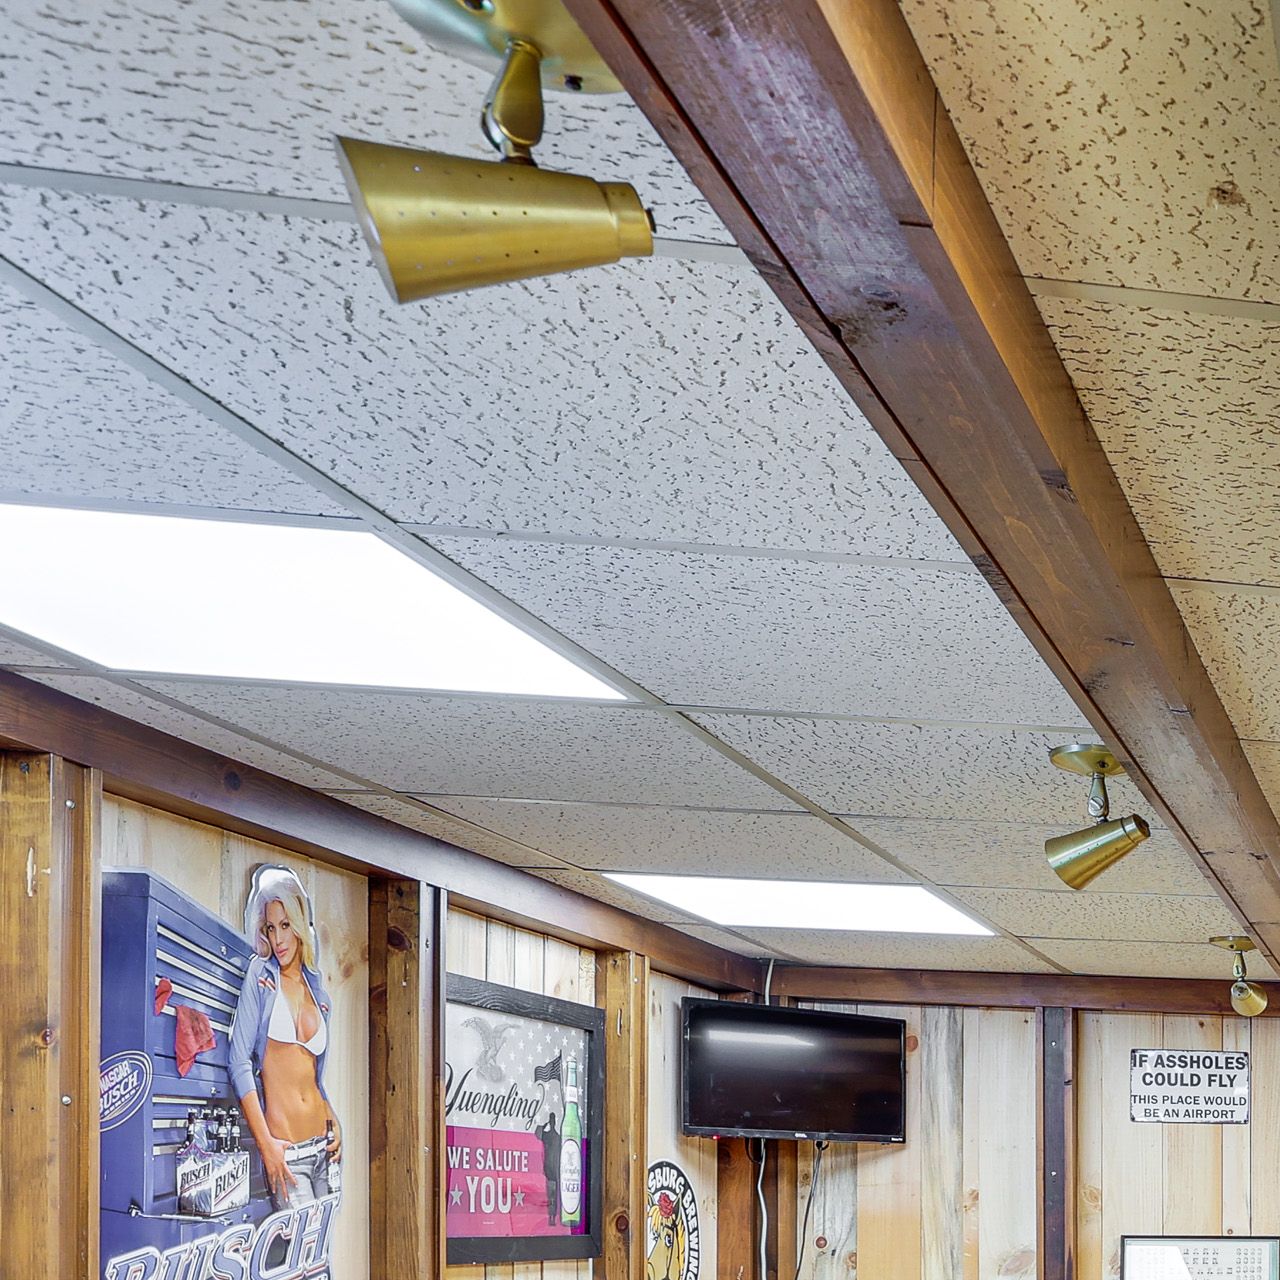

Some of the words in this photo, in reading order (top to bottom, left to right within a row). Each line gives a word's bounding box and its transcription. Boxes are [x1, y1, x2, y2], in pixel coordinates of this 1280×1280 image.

[1132, 1054, 1148, 1068] IF
[1154, 1054, 1246, 1070] ASSHOLES
[100, 1059, 131, 1094] NASCAR
[1142, 1072, 1202, 1087] COULD
[1207, 1074, 1237, 1088] FLY
[445, 1061, 546, 1131] Yuengling
[1131, 1094, 1158, 1104] THIS
[1162, 1095, 1200, 1105] PLACE
[1203, 1096, 1247, 1106] WOULD
[1144, 1108, 1159, 1118] BE
[1163, 1108, 1180, 1118] AN
[1183, 1109, 1236, 1119] AIRPORT
[448, 1146, 471, 1169] WE
[476, 1148, 529, 1173] SALUTE
[181, 1162, 211, 1190] BUSCH
[215, 1155, 249, 1197] BUSCH
[466, 1175, 512, 1214] YOU
